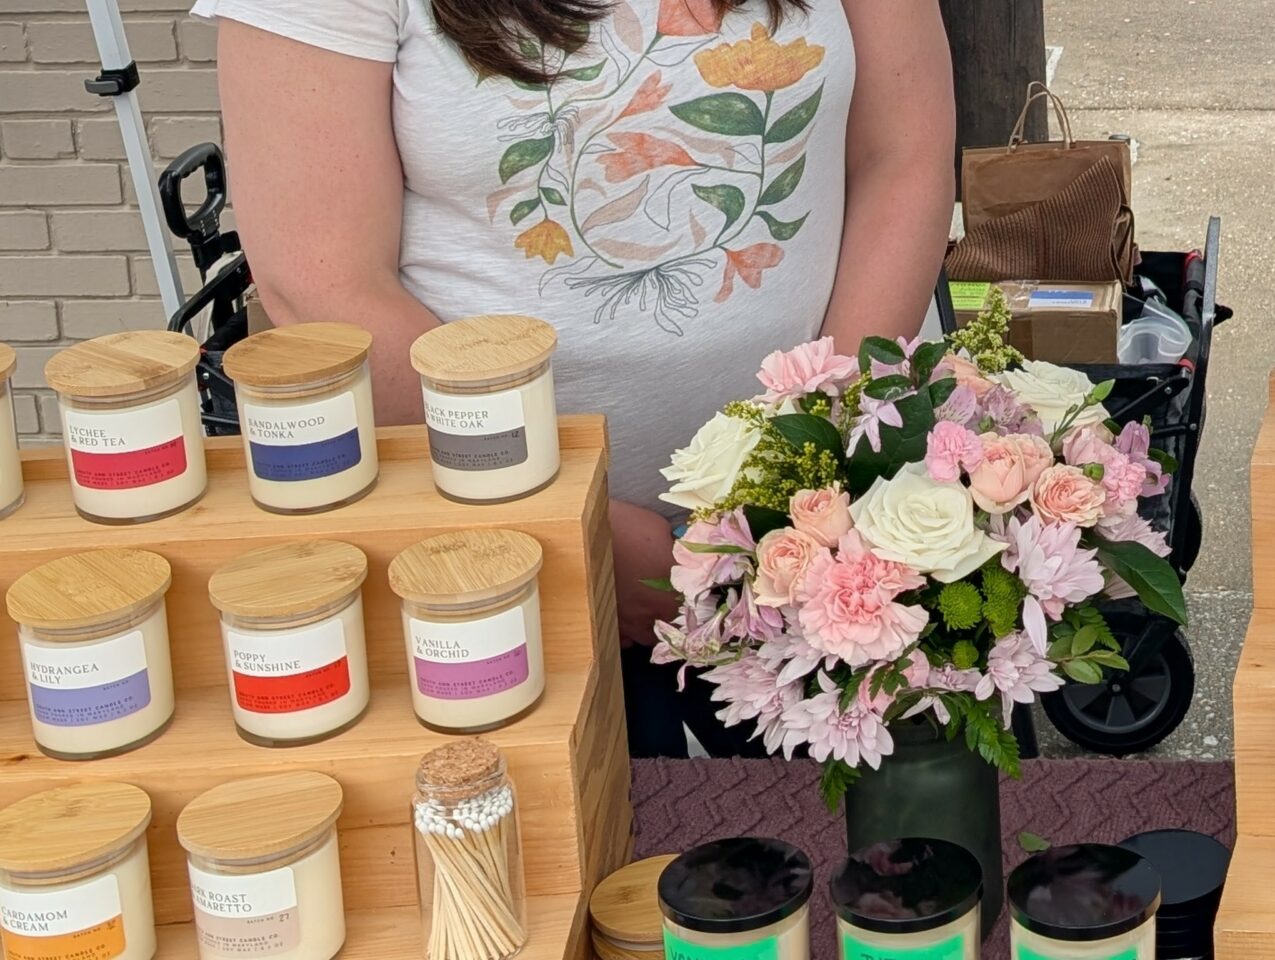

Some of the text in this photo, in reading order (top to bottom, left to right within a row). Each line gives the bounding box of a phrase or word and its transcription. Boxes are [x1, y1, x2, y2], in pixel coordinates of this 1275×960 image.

[430, 413, 456, 428] WHITE
[460, 420, 484, 429] OAK
[448, 410, 489, 420] PEPPER
[248, 416, 326, 430] SANDALWOOD
[69, 425, 106, 438] LYCHEE
[258, 429, 295, 440] TONKA
[79, 438, 98, 446] RED
[103, 438, 125, 447] TEA
[415, 635, 461, 649] VANILLA
[233, 650, 266, 663] POPPY
[425, 648, 470, 659] ORCHID
[30, 662, 100, 676] HYDRANGEA
[243, 660, 301, 672] SUNSHINE
[40, 674, 61, 685] LILY
[208, 891, 247, 903] ROAST
[1, 906, 68, 922] CARDAMOM
[10, 919, 49, 932] CREAM
